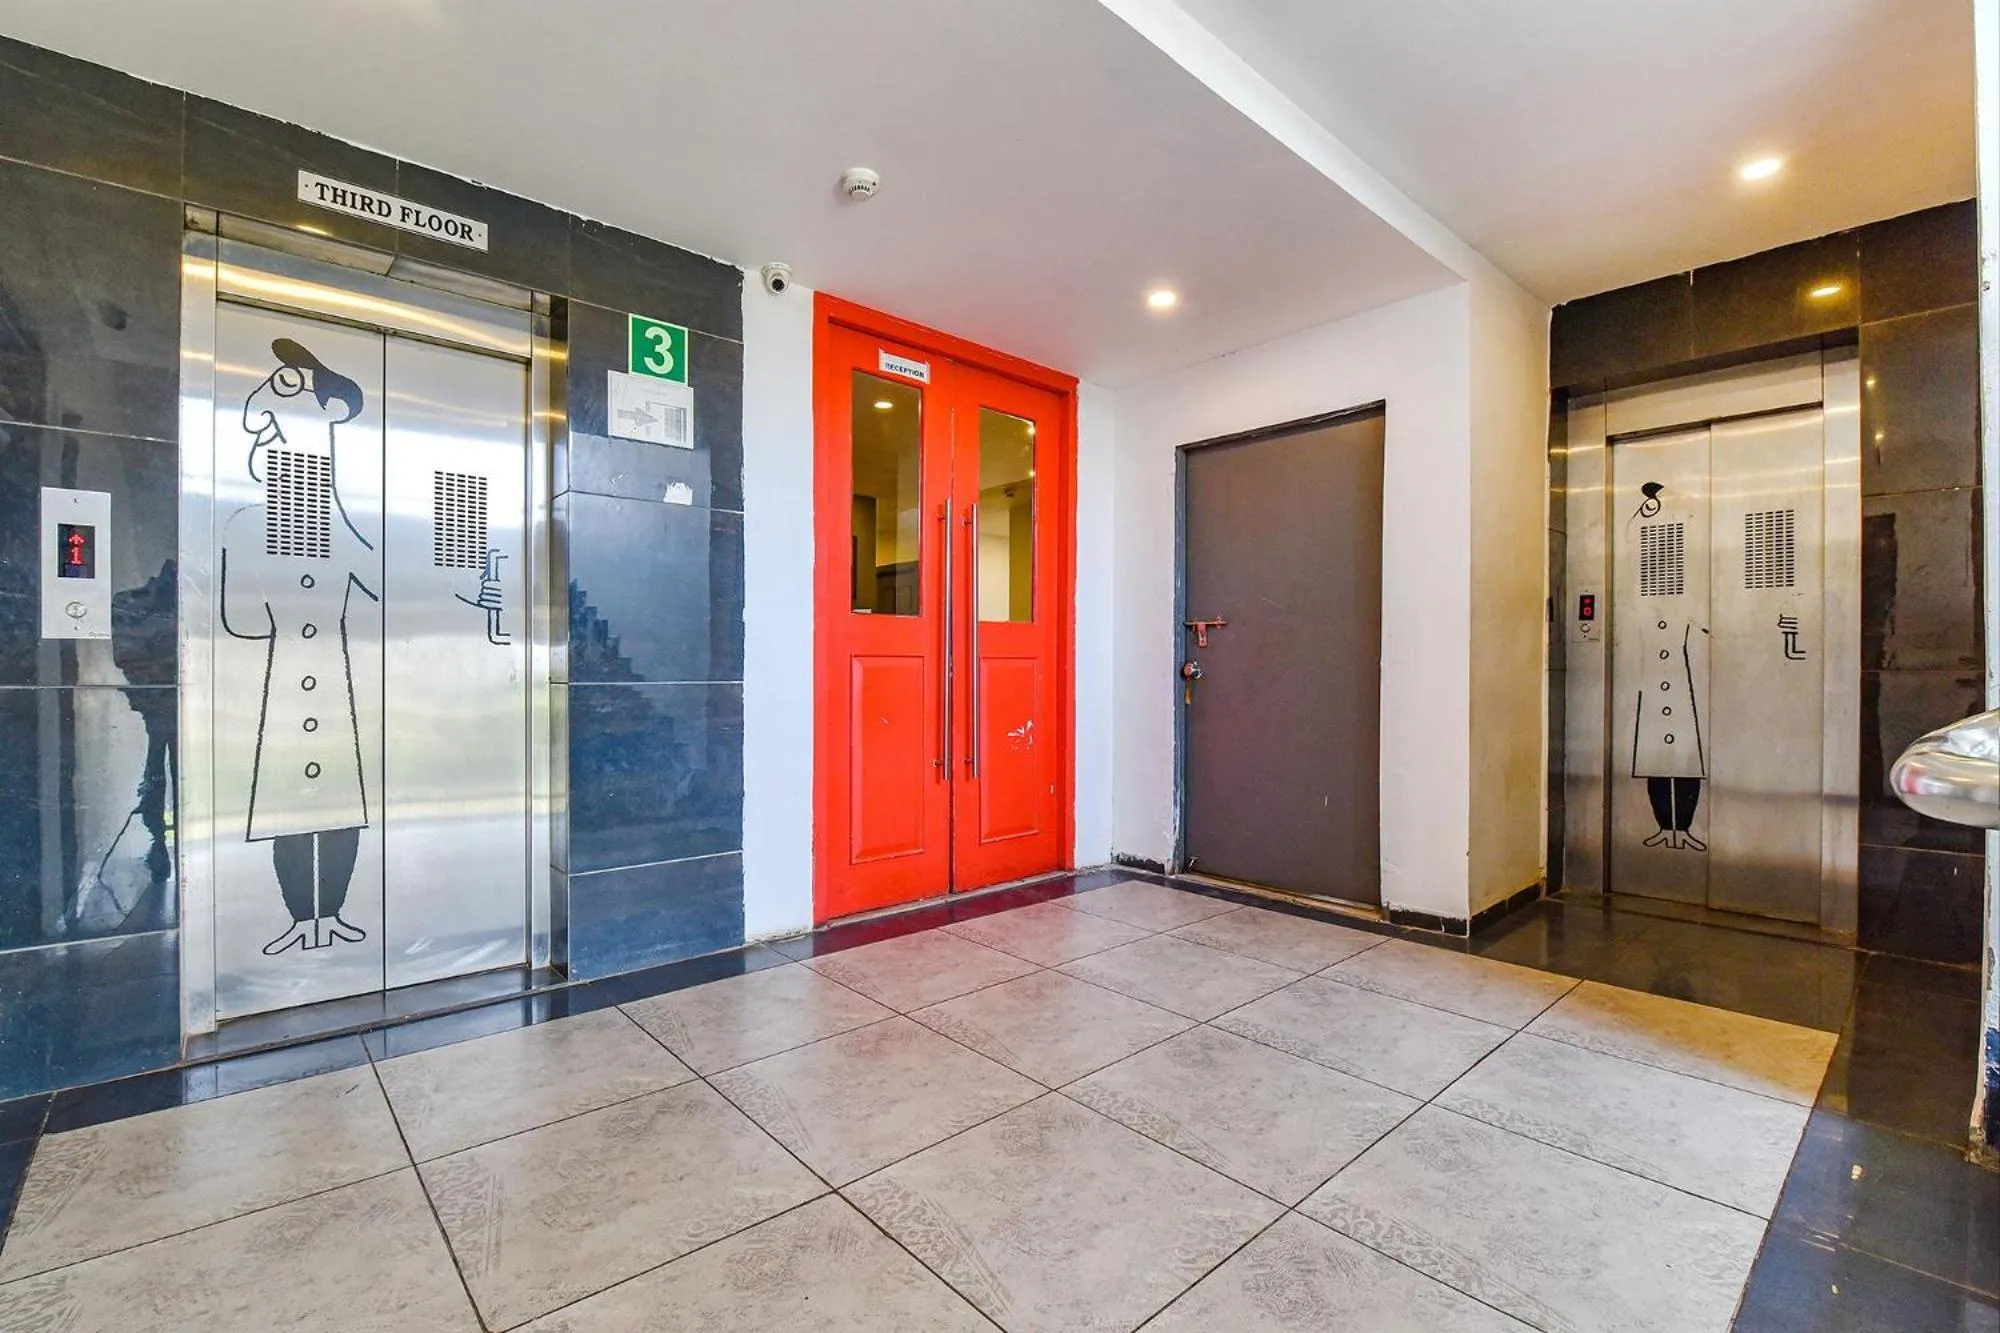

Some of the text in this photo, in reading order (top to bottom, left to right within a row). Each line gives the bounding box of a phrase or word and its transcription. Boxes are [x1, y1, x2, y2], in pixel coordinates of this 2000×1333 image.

[315, 182, 474, 241] THIRD FLOOR
[643, 326, 674, 374] 3
[885, 362, 925, 379] RECEPTION
[71, 546, 84, 565] 1
